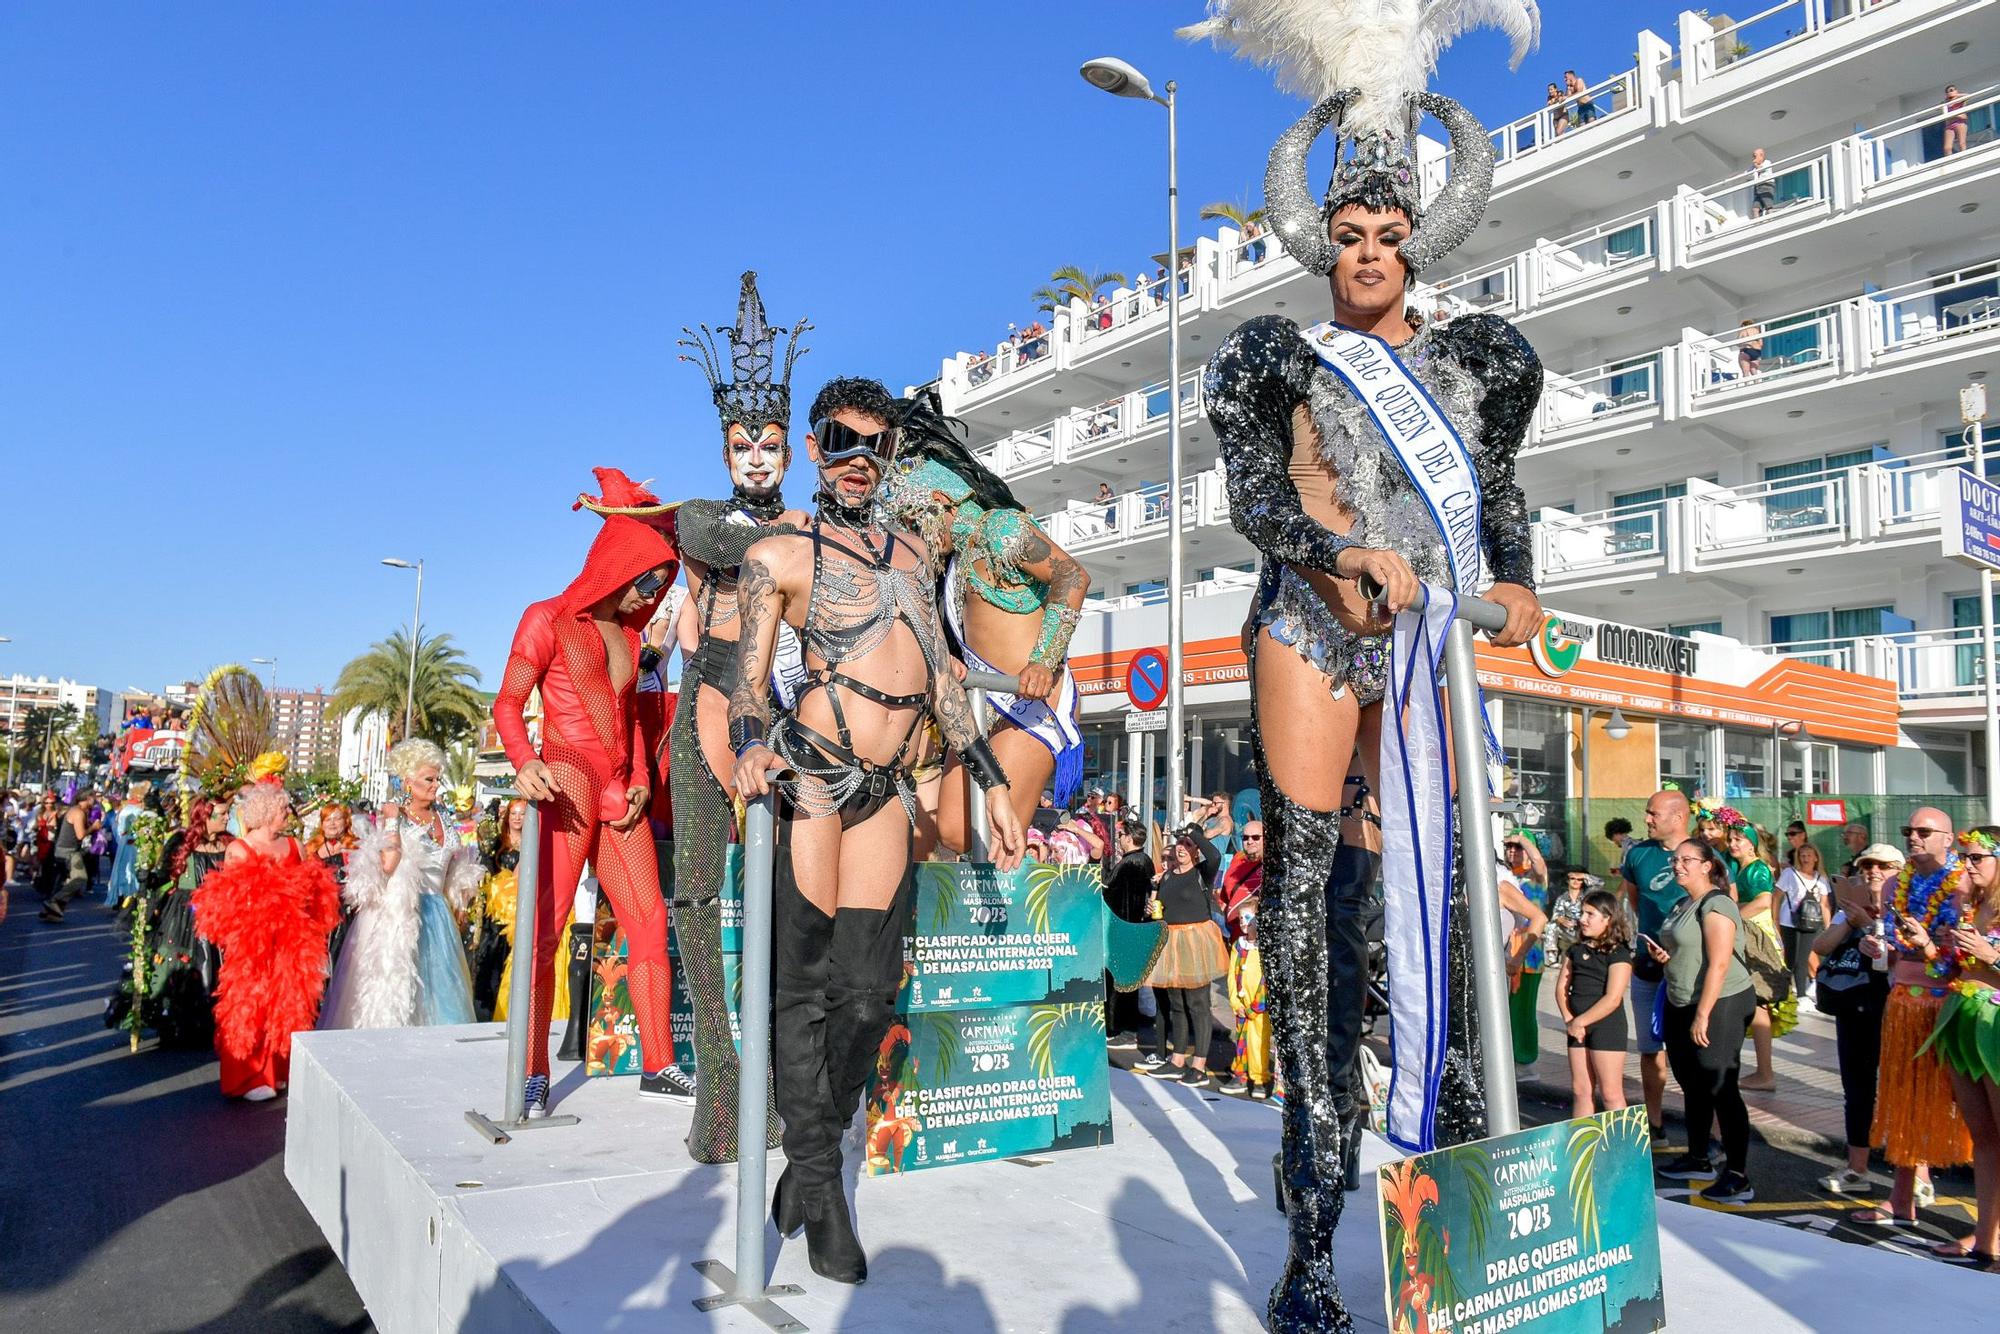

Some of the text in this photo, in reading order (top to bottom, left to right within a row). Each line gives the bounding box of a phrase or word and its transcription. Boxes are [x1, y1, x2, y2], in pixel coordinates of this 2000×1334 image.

[1337, 340, 1391, 381] DRAG
[1375, 384, 1436, 442] QUEEN
[1415, 440, 1459, 484] DEL
[1597, 622, 1700, 676] MARKET
[1077, 680, 1121, 693] OBACCO
[1514, 680, 1562, 695] TOBACCO
[1570, 688, 1624, 703] SOUVENIRS
[960, 878, 1016, 892] CARNAVAL
[963, 897, 1013, 906] MASPALOMAS
[969, 906, 1008, 924] 2023
[915, 934, 997, 948] CLASIFICADO
[998, 934, 1031, 945] DRAG
[1033, 933, 1070, 945] QUEEN
[915, 948, 985, 961] CARNAVAL
[986, 945, 1078, 959] INTERNACIONAL
[923, 958, 1053, 975] DE MASPALOMAS 2023
[614, 1024, 634, 1035] DEL
[961, 1022, 1018, 1039] CARNAVAL
[964, 1043, 1015, 1054] MASPALOMAS
[971, 1053, 1010, 1072] 2023
[919, 1082, 1002, 1101] CLASIFICADO
[1003, 1079, 1037, 1092] DRAG
[1038, 1075, 1076, 1089] QUEEN
[895, 1087, 1084, 1119] DEL CARNAVAL INTERNACIONAL
[926, 1102, 1058, 1130] DE MASPALOMAS 2023
[1494, 1151, 1558, 1187] CARNAVAL
[1500, 1185, 1556, 1212] MASPALOMAS
[1504, 1182, 1542, 1197] INTERNACIONAL
[1507, 1203, 1552, 1240] 2023
[1486, 1236, 1579, 1285] DRAG QUEEN
[1427, 1244, 1633, 1332] DEL CARNAVAL INTERNACIONAL
[1483, 1290, 1579, 1334] MASPALOMAS
[1578, 1274, 1608, 1299] 2023
